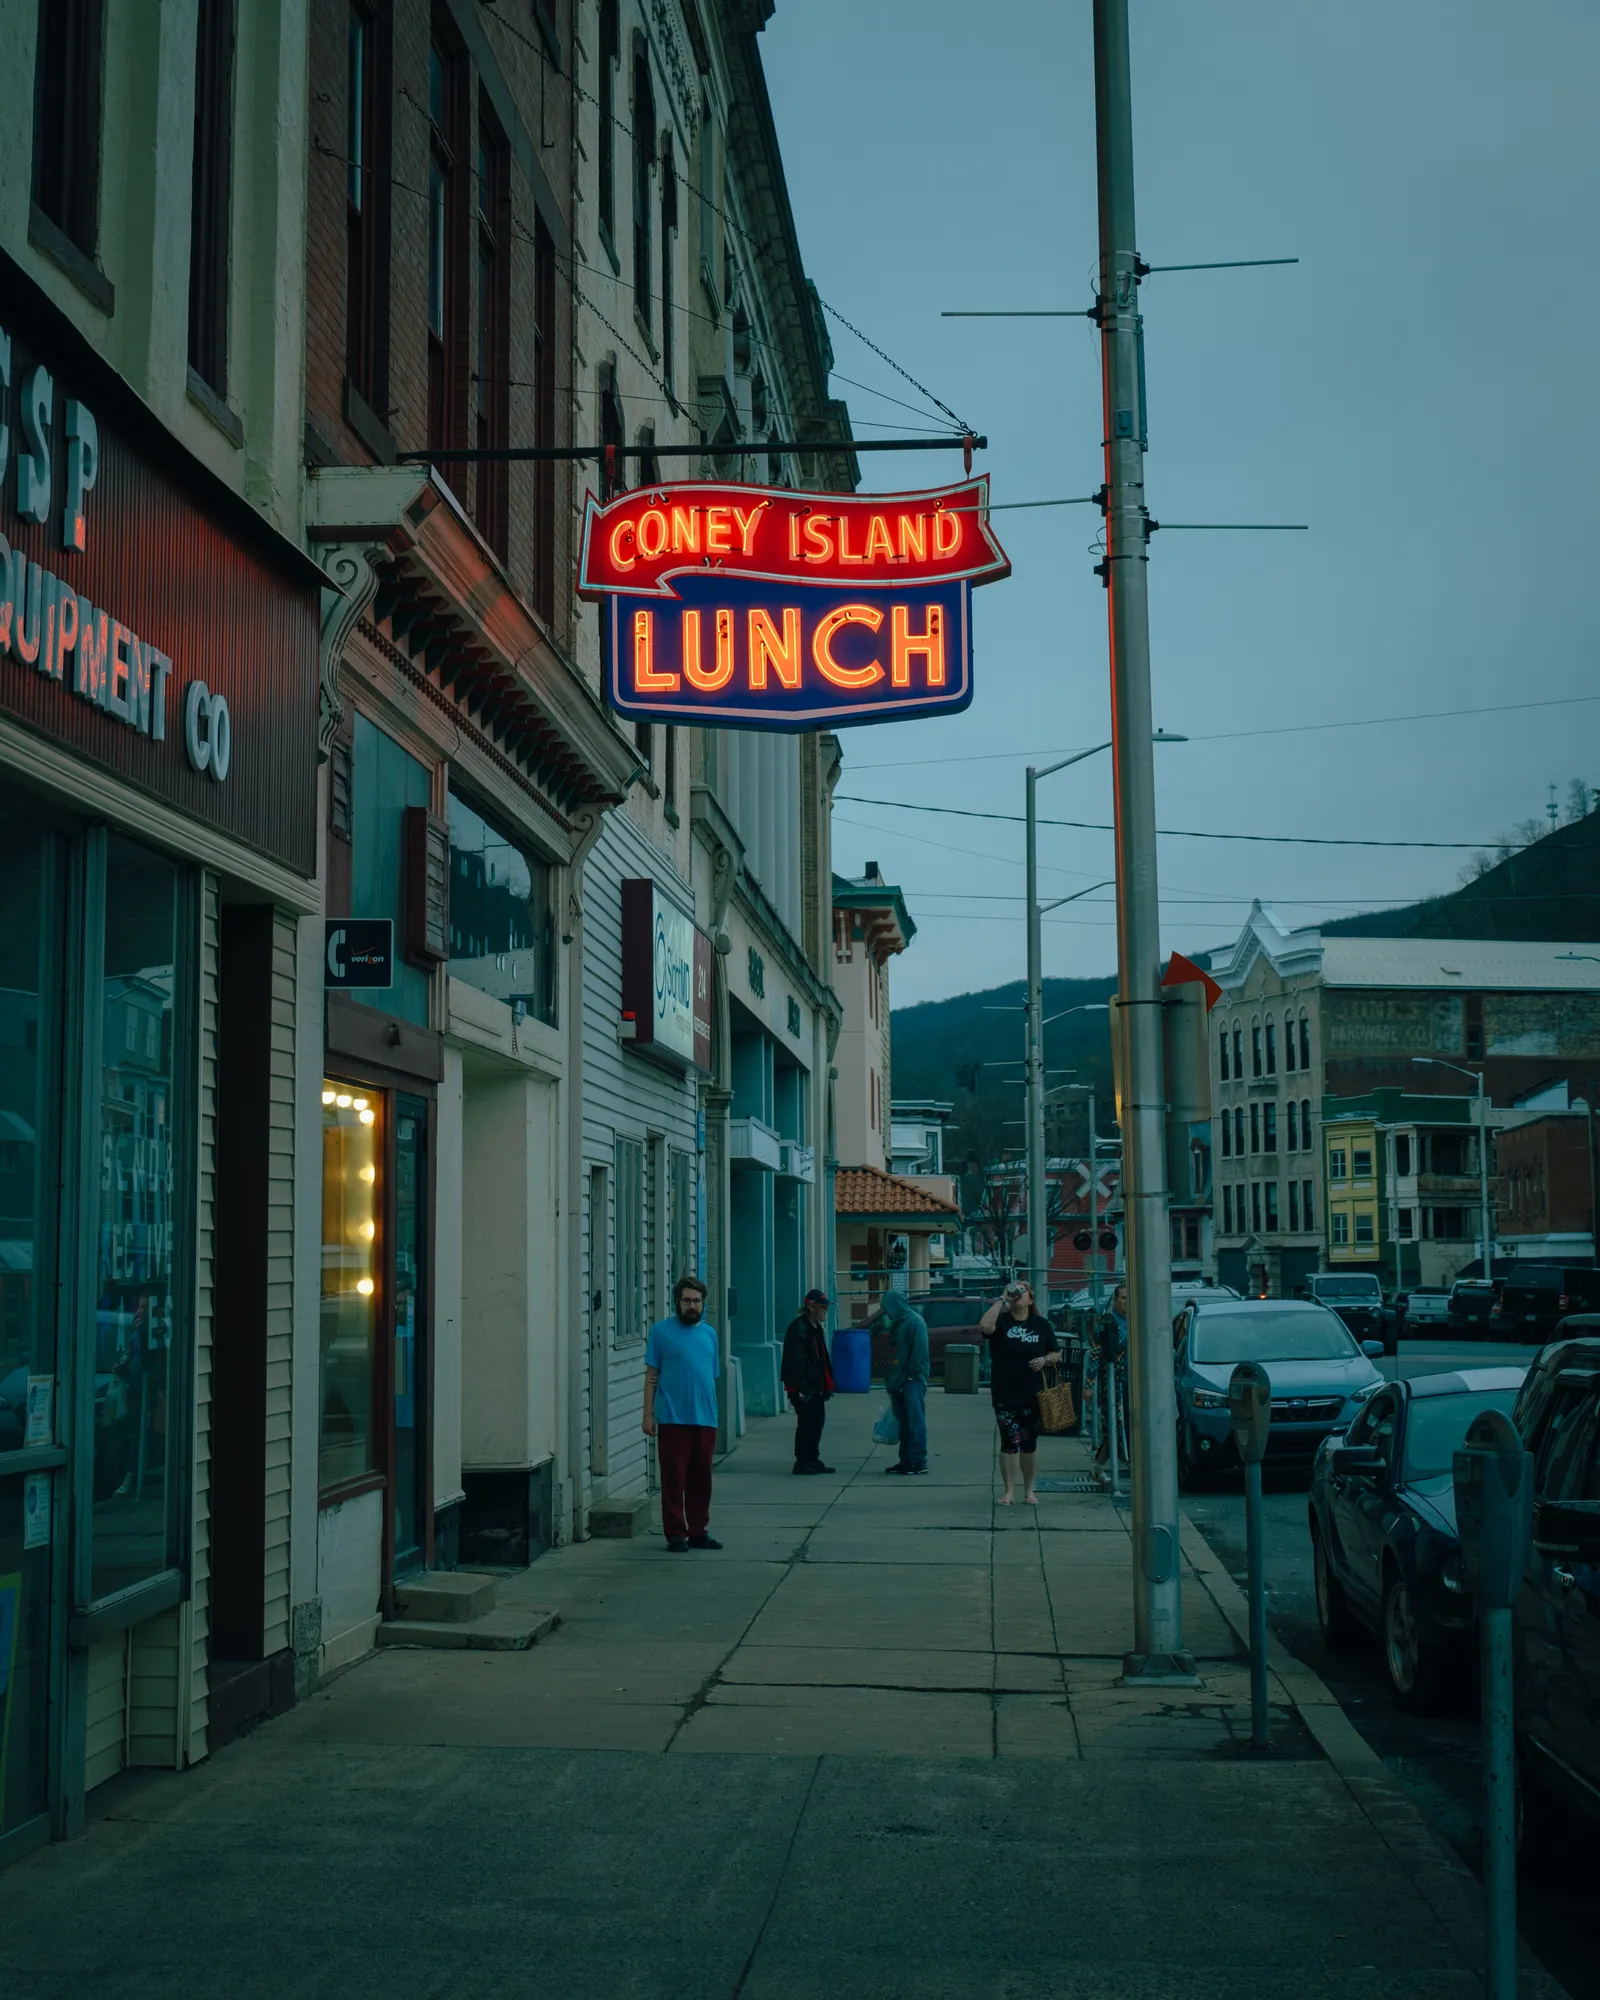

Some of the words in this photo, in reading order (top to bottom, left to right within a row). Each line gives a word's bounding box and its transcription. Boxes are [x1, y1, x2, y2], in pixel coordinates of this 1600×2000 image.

[609, 503, 766, 572] CONEY
[788, 507, 963, 564] ISLAND
[634, 604, 946, 693] LUNCH
[185, 680, 231, 783] CO
[351, 955, 384, 965] verizon
[1331, 1024, 1398, 1043] HARDWARE
[102, 1134, 159, 1192] SEND
[164, 1141, 174, 1194] &
[102, 1220, 173, 1280] ECIVE
[103, 1295, 173, 1351] AES
